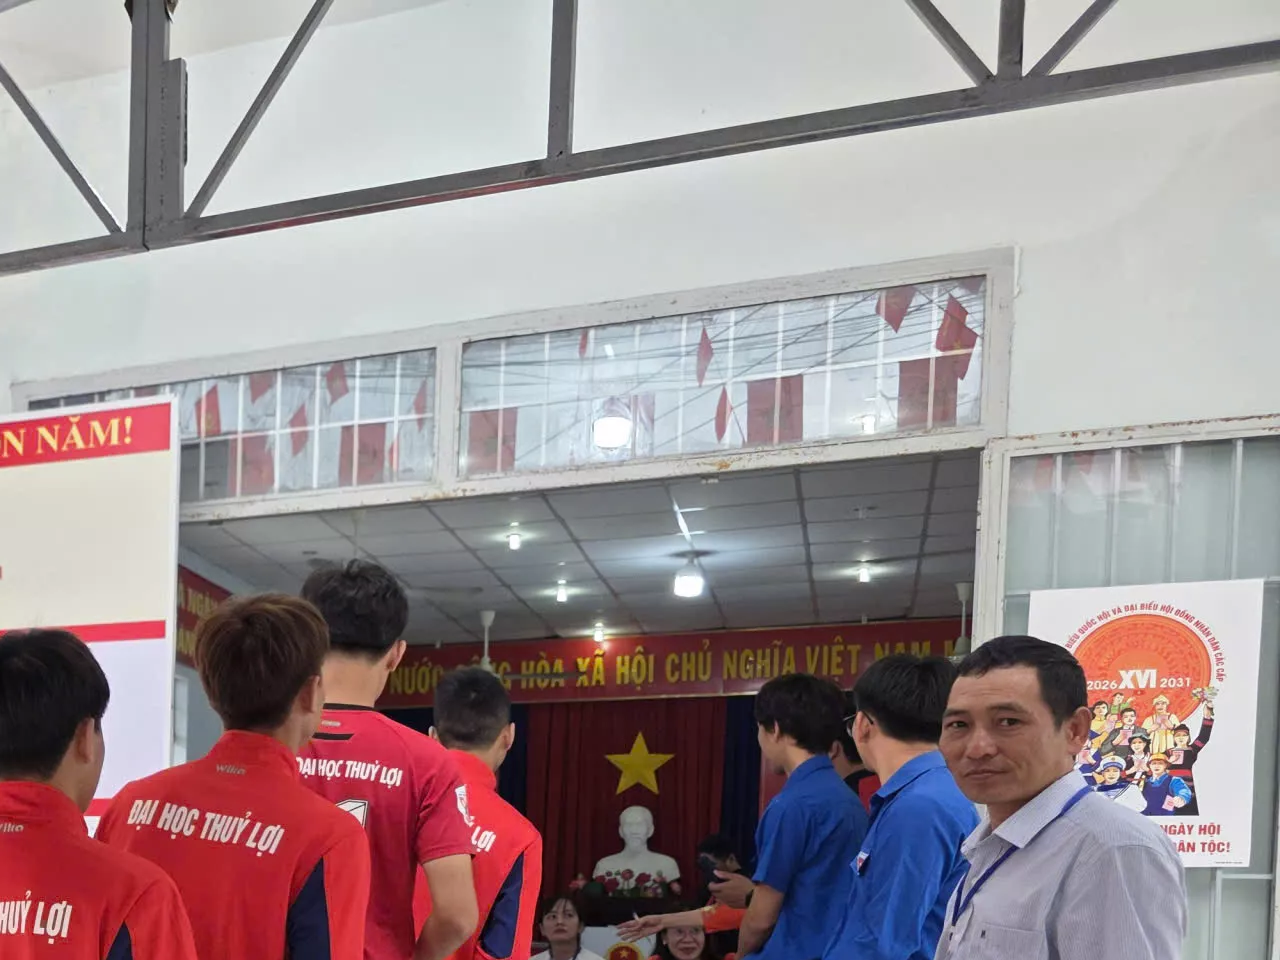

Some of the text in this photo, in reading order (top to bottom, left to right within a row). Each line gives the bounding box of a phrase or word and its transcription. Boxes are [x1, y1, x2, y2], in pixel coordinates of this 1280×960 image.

[36, 415, 133, 455] NĂM!
[521, 652, 565, 689] HÒA
[576, 648, 605, 687] XÃ
[616, 645, 655, 691] HỘI
[666, 639, 713, 683] CHỦ
[723, 640, 797, 680] NGHĨA
[806, 635, 862, 682] VIỆT
[1087, 668, 1191, 691] 2026 XVI 2031
[318, 758, 344, 780] HỌC
[380, 766, 404, 788] LỢI
[127, 799, 285, 857] ĐẠI HỌC THUỶ LỢI
[470, 825, 497, 853] LỢI
[1198, 822, 1221, 838] HỘI
[1200, 839, 1231, 855] TỘC!
[33, 900, 73, 944] LỢI
